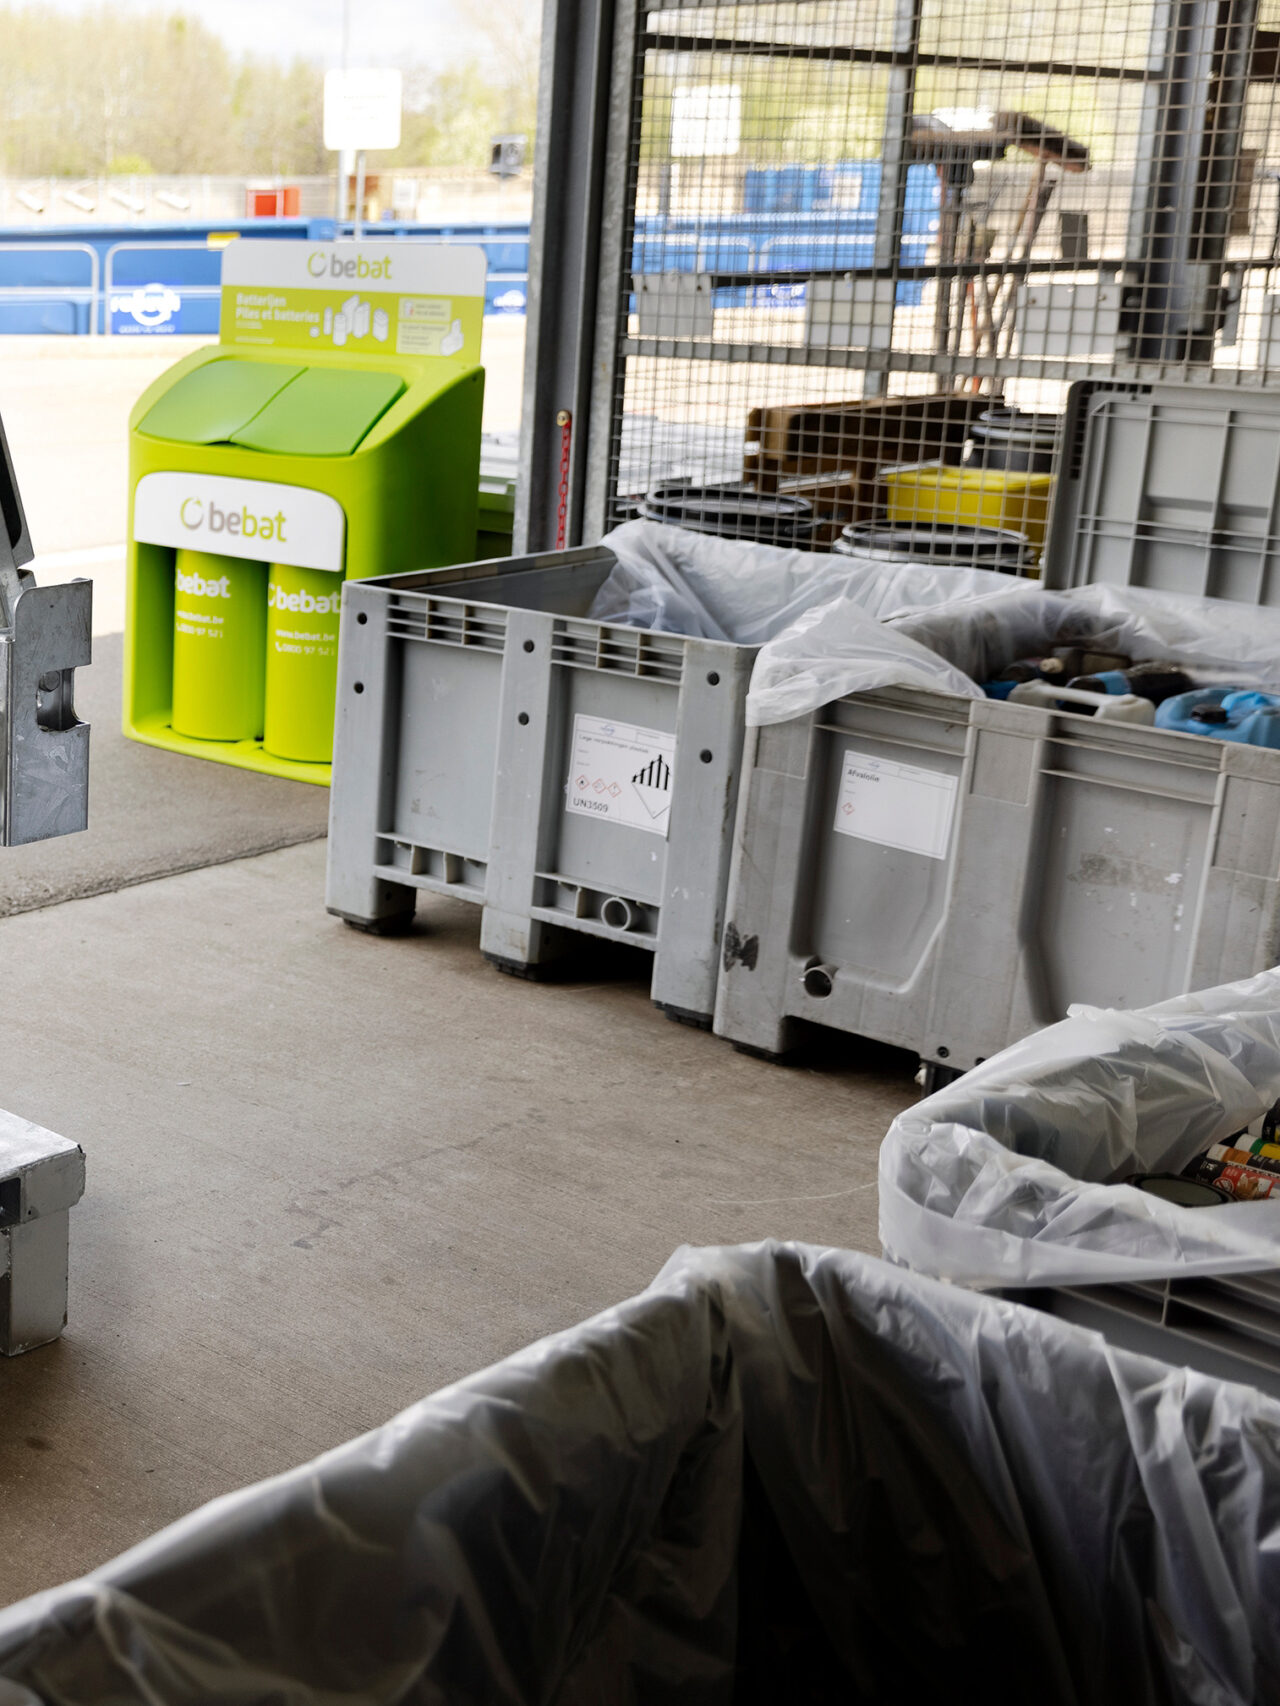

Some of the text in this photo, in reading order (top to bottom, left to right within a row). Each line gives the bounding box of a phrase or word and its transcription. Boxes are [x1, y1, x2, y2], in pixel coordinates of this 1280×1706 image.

[331, 254, 392, 280] bebat
[236, 292, 286, 309] Batterijen
[236, 307, 260, 320] Piles
[274, 308, 320, 323] batteries
[208, 501, 287, 543] bebat
[176, 568, 231, 598] bebat
[276, 585, 341, 614] bebat
[573, 797, 609, 813] UN3509
